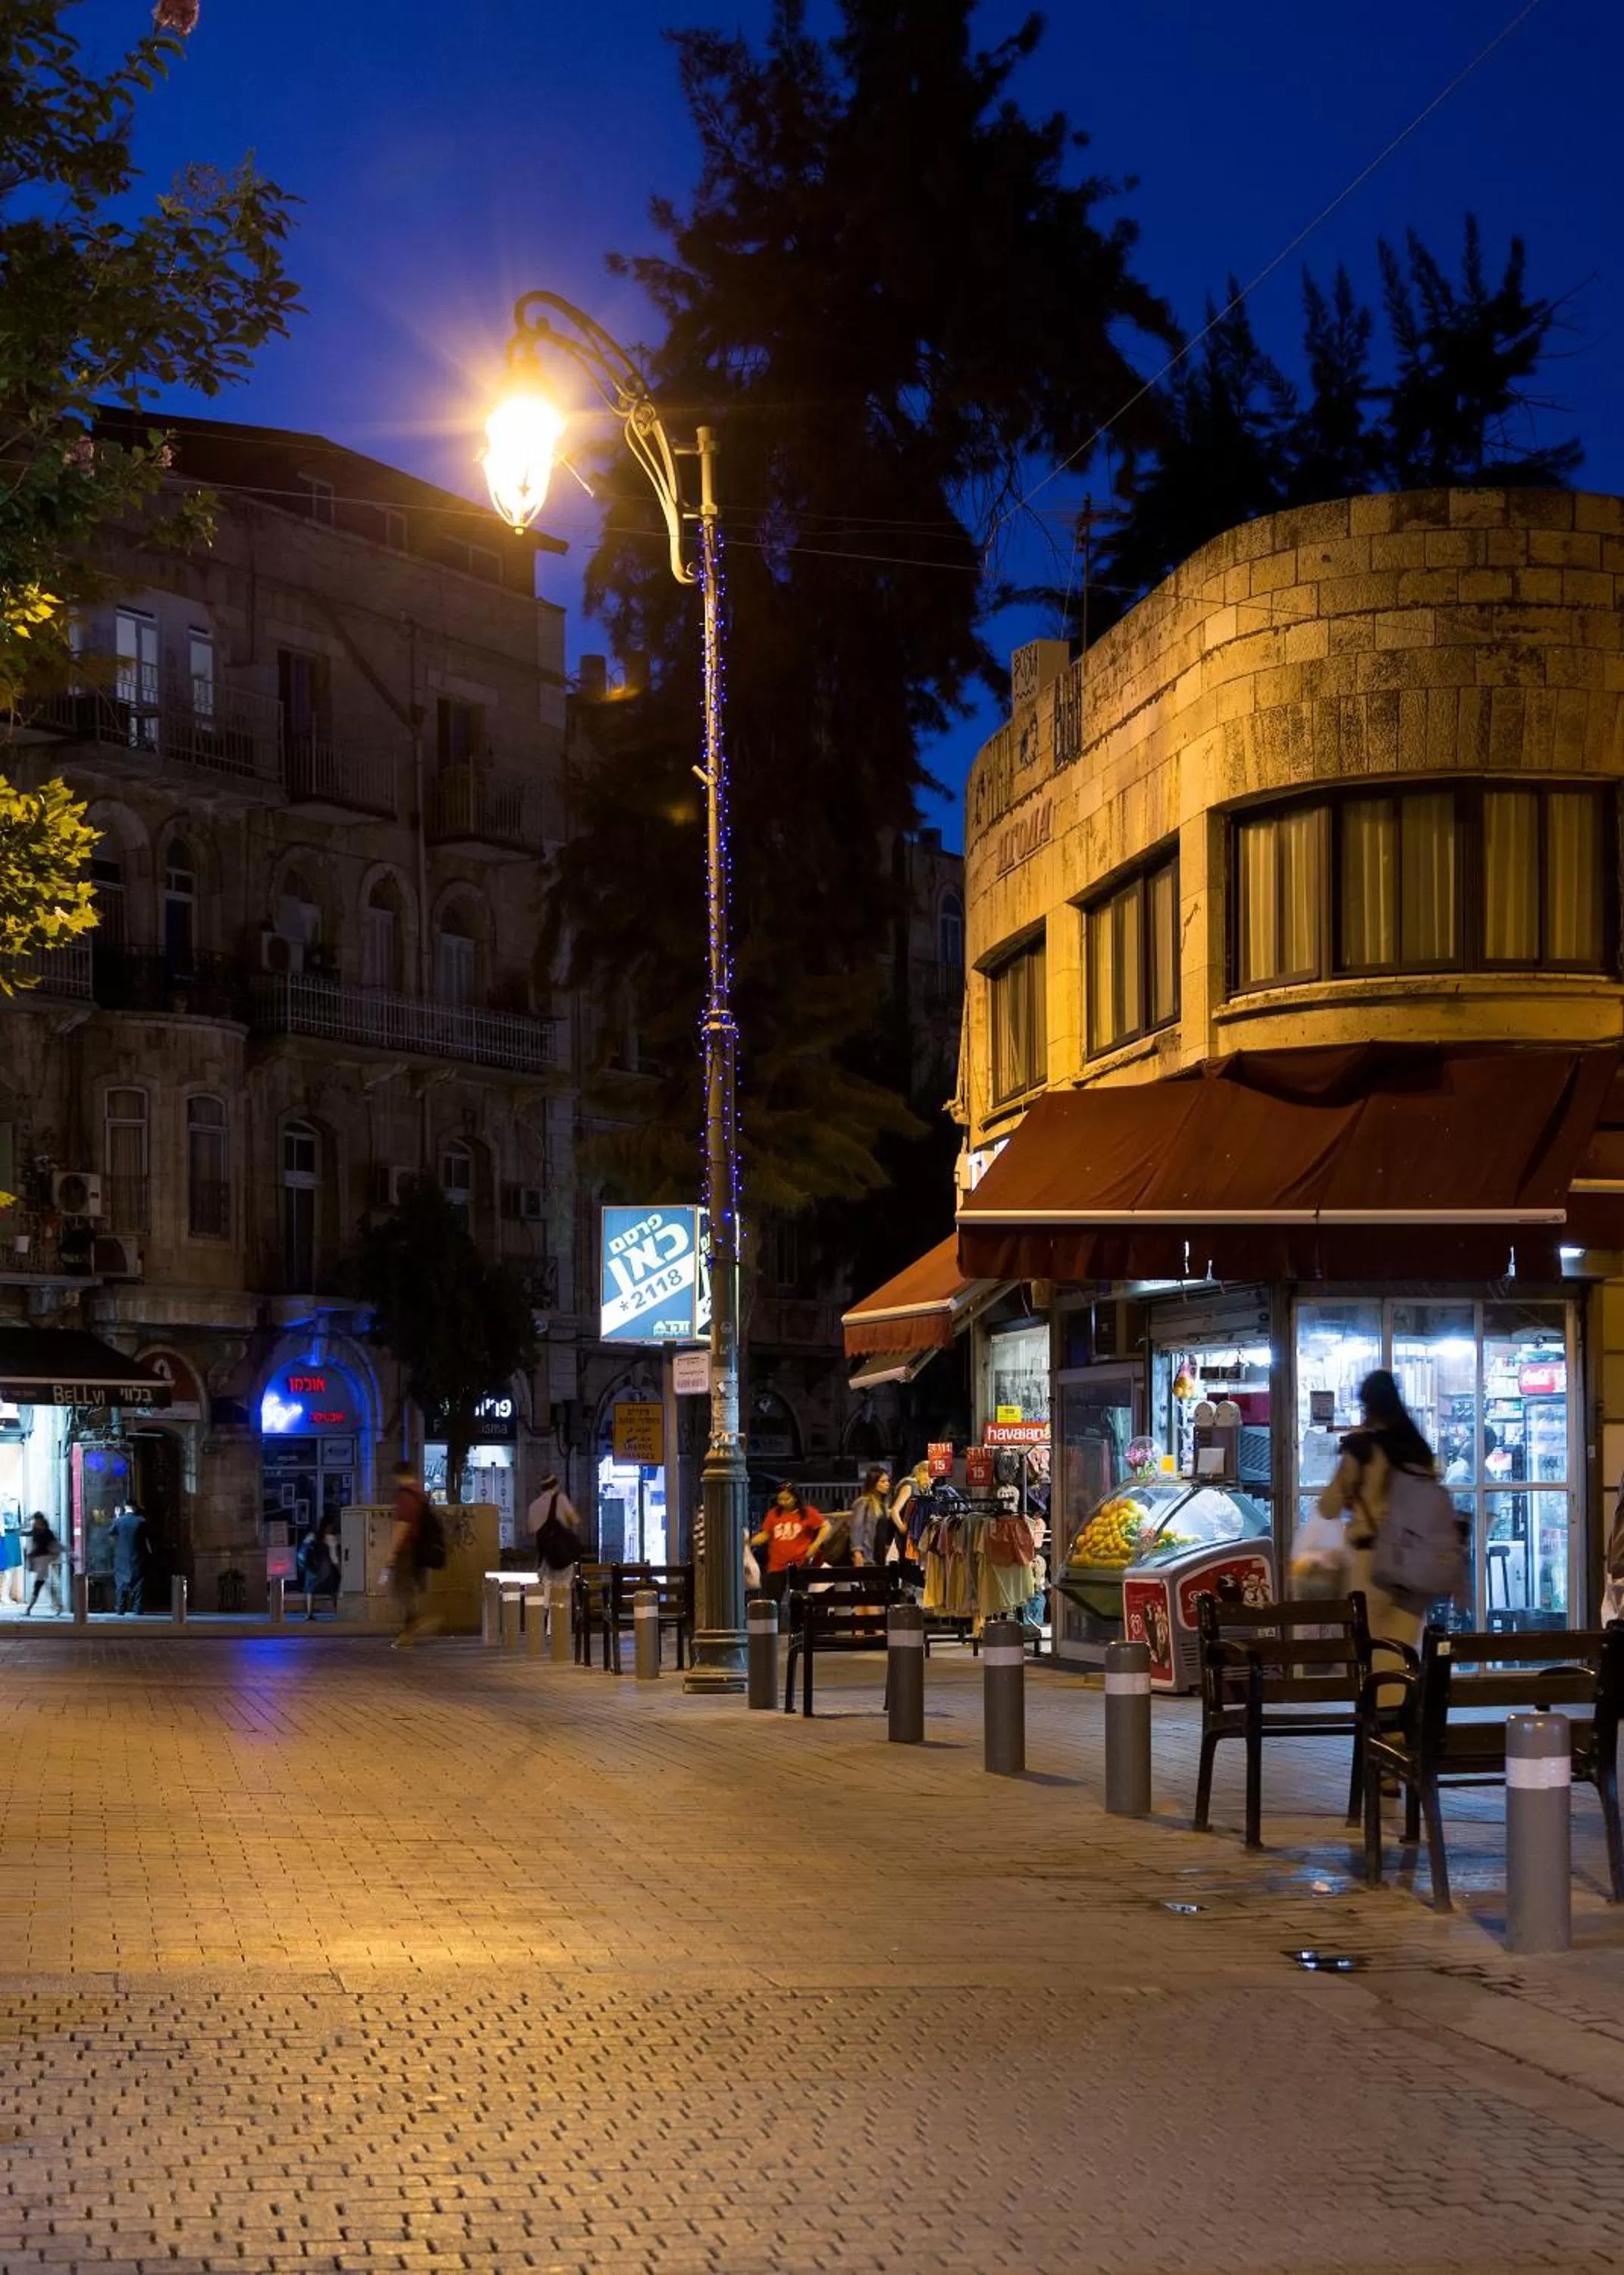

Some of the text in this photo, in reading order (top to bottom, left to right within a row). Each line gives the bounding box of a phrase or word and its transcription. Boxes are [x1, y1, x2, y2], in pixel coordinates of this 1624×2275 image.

[609, 1213, 663, 1255] פרסם
[607, 1223, 689, 1294] כאן
[971, 1467, 985, 1480] 15
